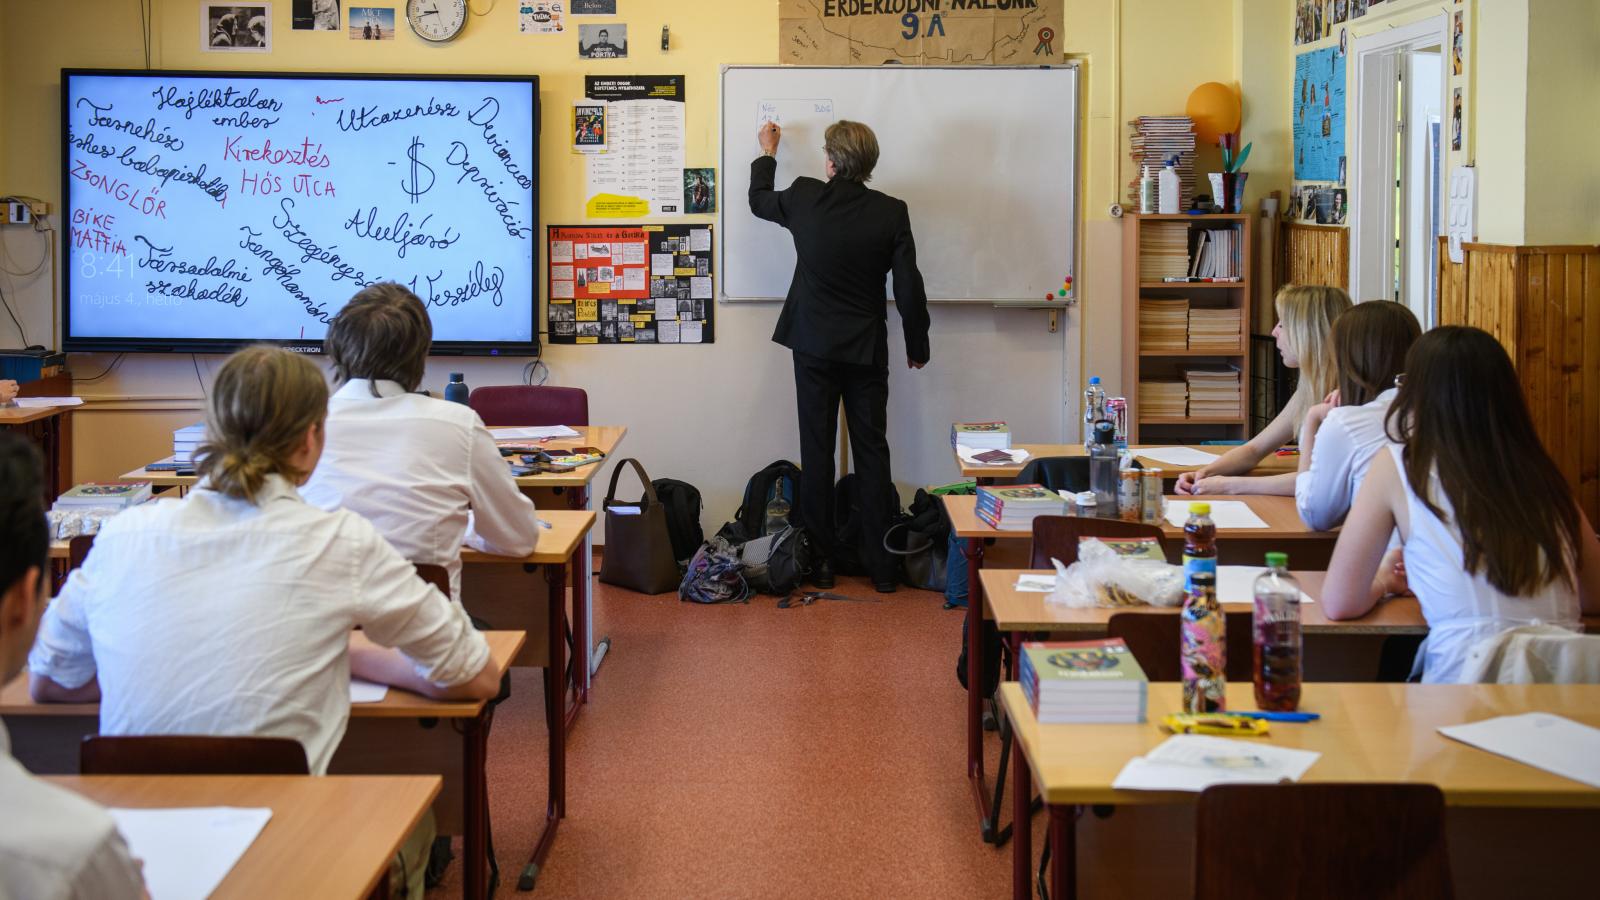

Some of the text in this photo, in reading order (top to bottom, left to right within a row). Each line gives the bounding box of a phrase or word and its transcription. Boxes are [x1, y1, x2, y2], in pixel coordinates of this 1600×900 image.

[152, 86, 283, 120] Hajléktalan
[336, 96, 460, 132] Utcazenész
[293, 174, 336, 197] UTCA
[345, 207, 460, 259] Aluljáró
[80, 252, 135, 280] 8:41
[134, 235, 252, 282] Társadalmi
[80, 290, 120, 309] május
[146, 279, 248, 307] szakadék
